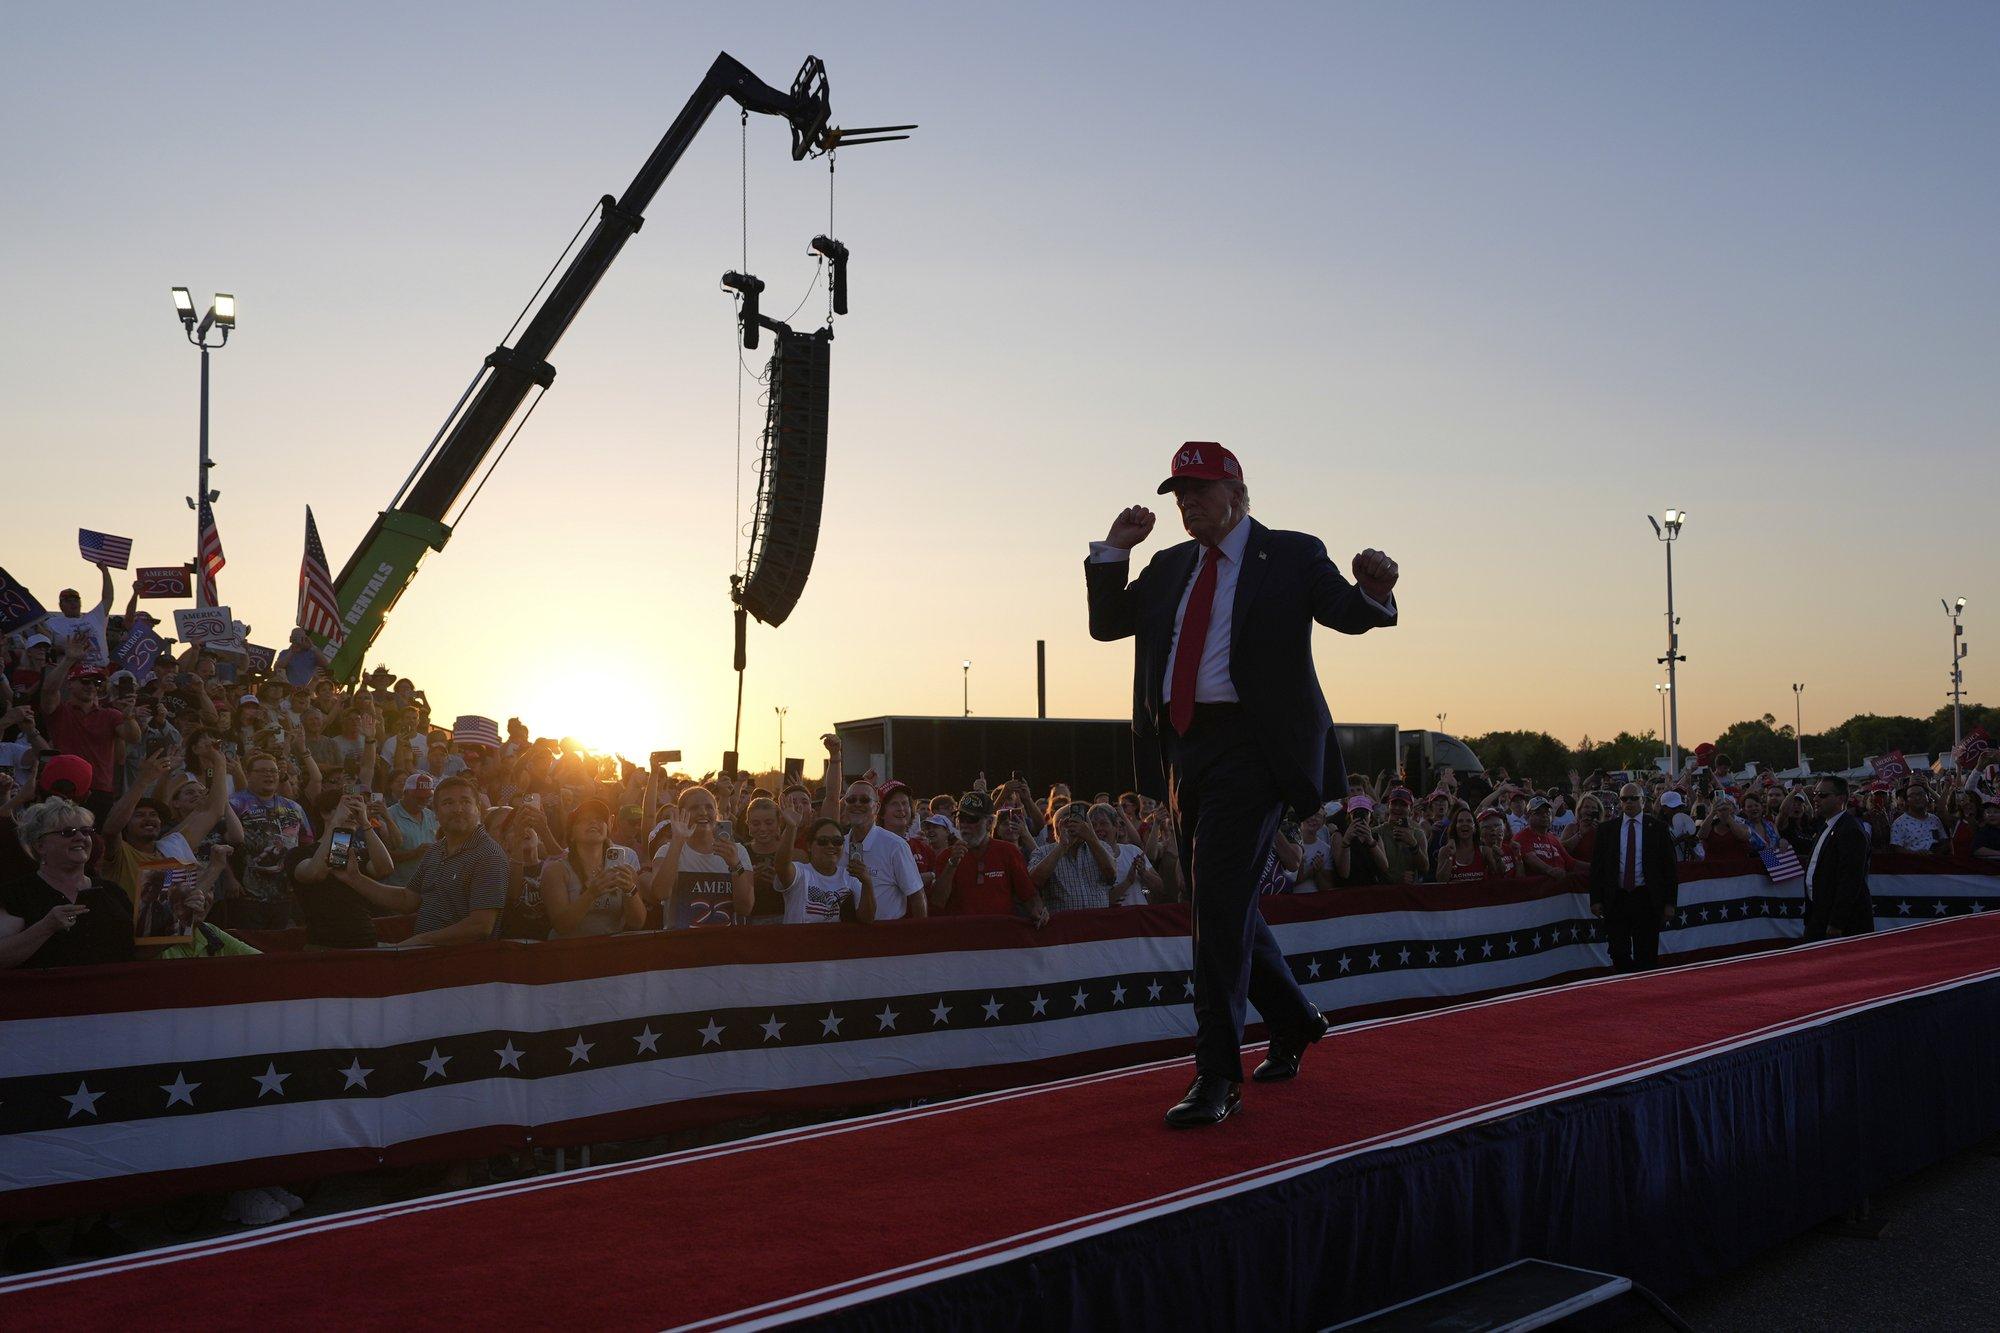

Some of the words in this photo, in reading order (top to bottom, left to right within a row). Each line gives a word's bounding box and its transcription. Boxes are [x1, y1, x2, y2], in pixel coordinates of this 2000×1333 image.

[144, 578, 184, 594] 250
[345, 562, 393, 624] RENTALS
[183, 611, 223, 620] AMERICA
[183, 618, 225, 638] 250
[117, 629, 144, 658] AMERICA
[127, 638, 159, 670] 250
[692, 881, 733, 894] AMER
[1261, 860, 1286, 895] 25
[689, 900, 734, 928] 25
